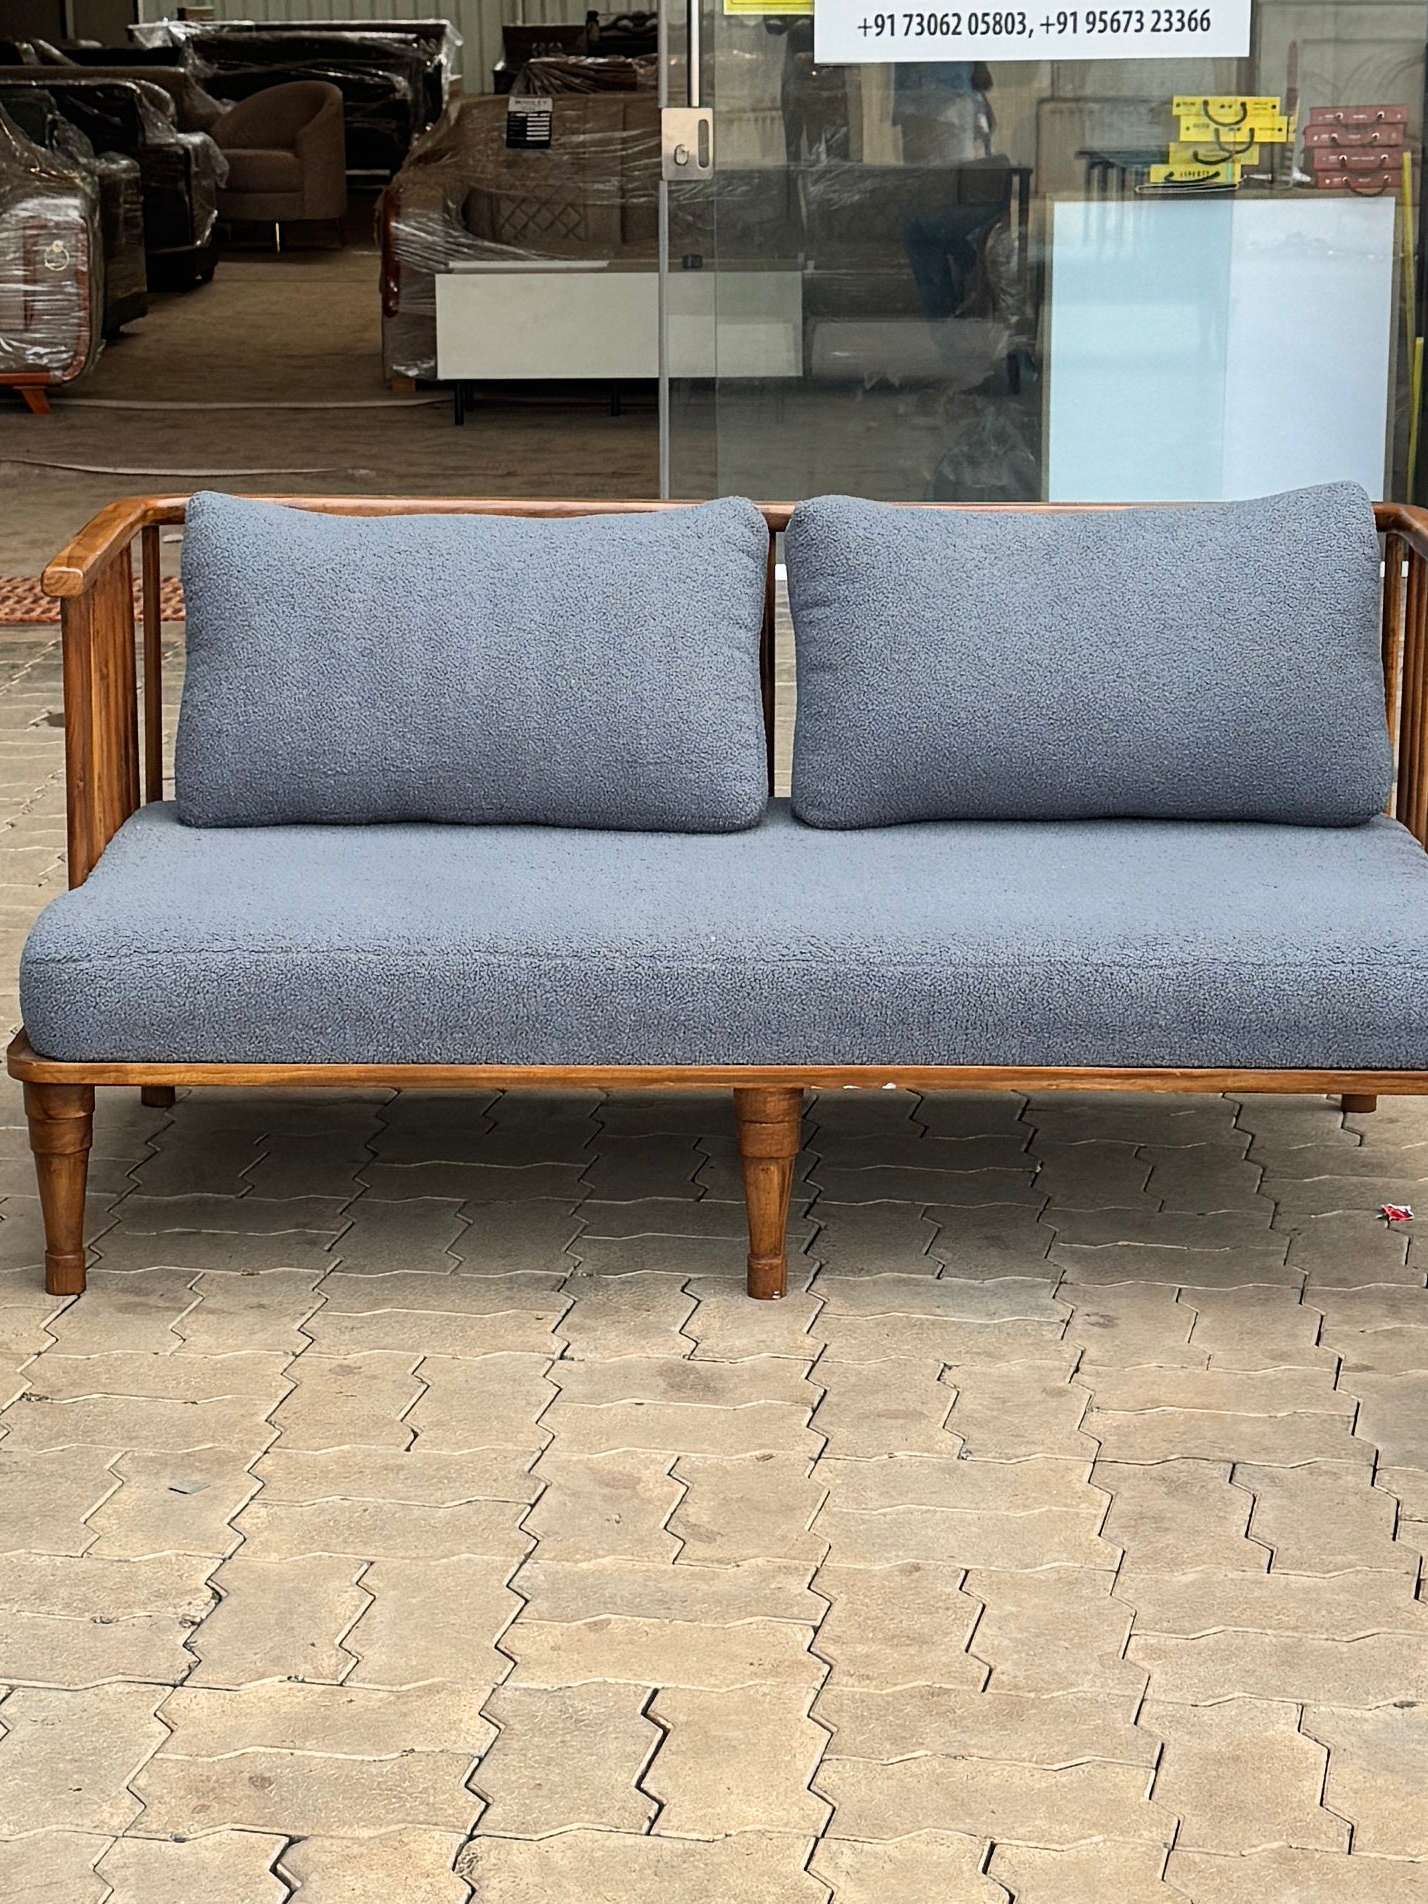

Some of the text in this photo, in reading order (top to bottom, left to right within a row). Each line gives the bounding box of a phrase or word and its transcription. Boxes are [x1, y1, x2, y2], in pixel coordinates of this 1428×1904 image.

[857, 8, 1211, 39] +91 73062 05803, +91 95673 23366
